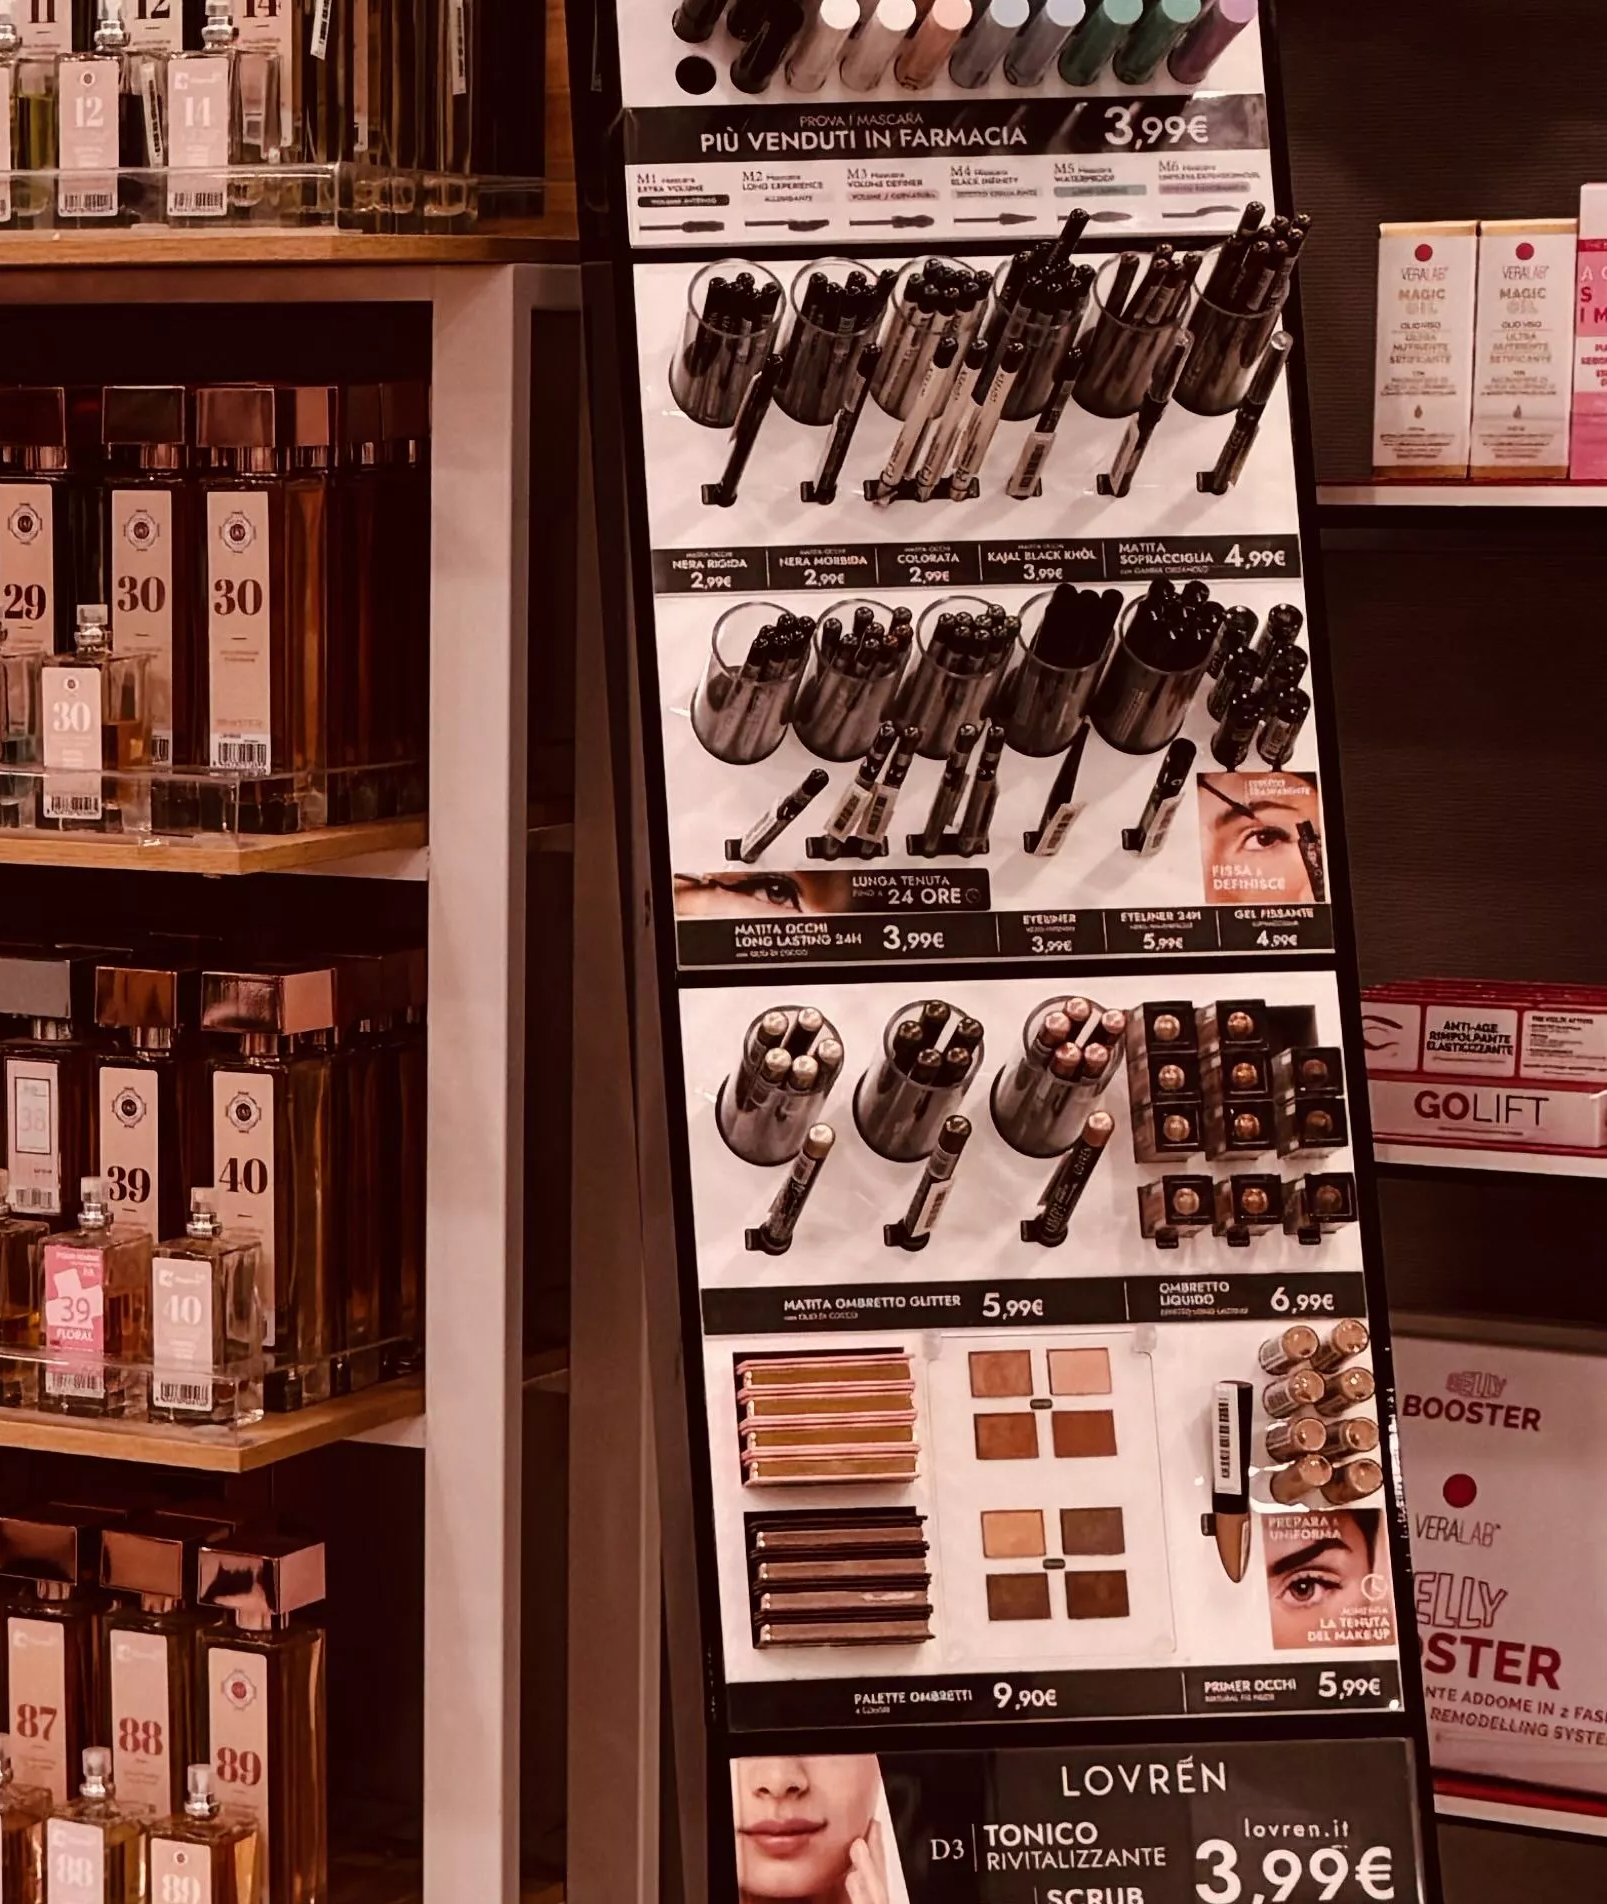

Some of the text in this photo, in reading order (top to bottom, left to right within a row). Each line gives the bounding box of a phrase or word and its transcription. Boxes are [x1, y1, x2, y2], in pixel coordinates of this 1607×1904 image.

[858, 112, 924, 127] MASCARA
[1103, 106, 1209, 151] 3,99€
[700, 125, 1028, 154] PIÙ VENDUTI IN FARMACIA
[897, 553, 959, 564] COLORATA
[1024, 550, 1061, 561] BLACK
[1119, 543, 1166, 553] MATITA
[1120, 553, 1214, 565] SOPRACCIGLIA
[1224, 544, 1286, 570] 4,99€
[691, 572, 731, 589] 2,99€
[804, 569, 844, 586] 2,99€
[909, 567, 950, 584] 2,99€
[1023, 564, 1063, 580] 3,99€
[4, 584, 47, 621] 29
[213, 578, 263, 616] 30
[901, 876, 950, 887] TENUTA
[888, 888, 961, 905] 24 ORE
[883, 925, 944, 952] 3,99€
[1414, 1090, 1549, 1126] GOLIFT
[107, 1165, 151, 1202] 39
[219, 1158, 268, 1195] 40
[1159, 1280, 1230, 1295] OMBRETTO
[1160, 1294, 1215, 1307] LIQUIDO
[1270, 1286, 1335, 1314] 6,99€
[783, 1294, 962, 1312] MATITA OMBRETTO GLITTER
[982, 1293, 1044, 1319] 5,99€
[1402, 1394, 1542, 1432] BOOSTER
[1413, 1571, 1509, 1631] ELLY
[992, 1682, 1058, 1710] 9,90€
[1203, 1678, 1296, 1695] PRIMER OCCHI
[1318, 1671, 1381, 1698] 5,99€
[853, 1689, 973, 1707] PALETTE OMBRETTI
[1461, 1688, 1569, 1718] ADDOME IN 2
[16, 1704, 58, 1741] 87
[1430, 1706, 1548, 1739] REMODELLING
[216, 1747, 262, 1786] 89
[1061, 1756, 1228, 1798] LOVRÉN
[930, 1822, 1098, 1861] D3 TONICO
[1243, 1819, 1350, 1839] lovren.it
[986, 1845, 1167, 1871] RIVITALIZZANTE
